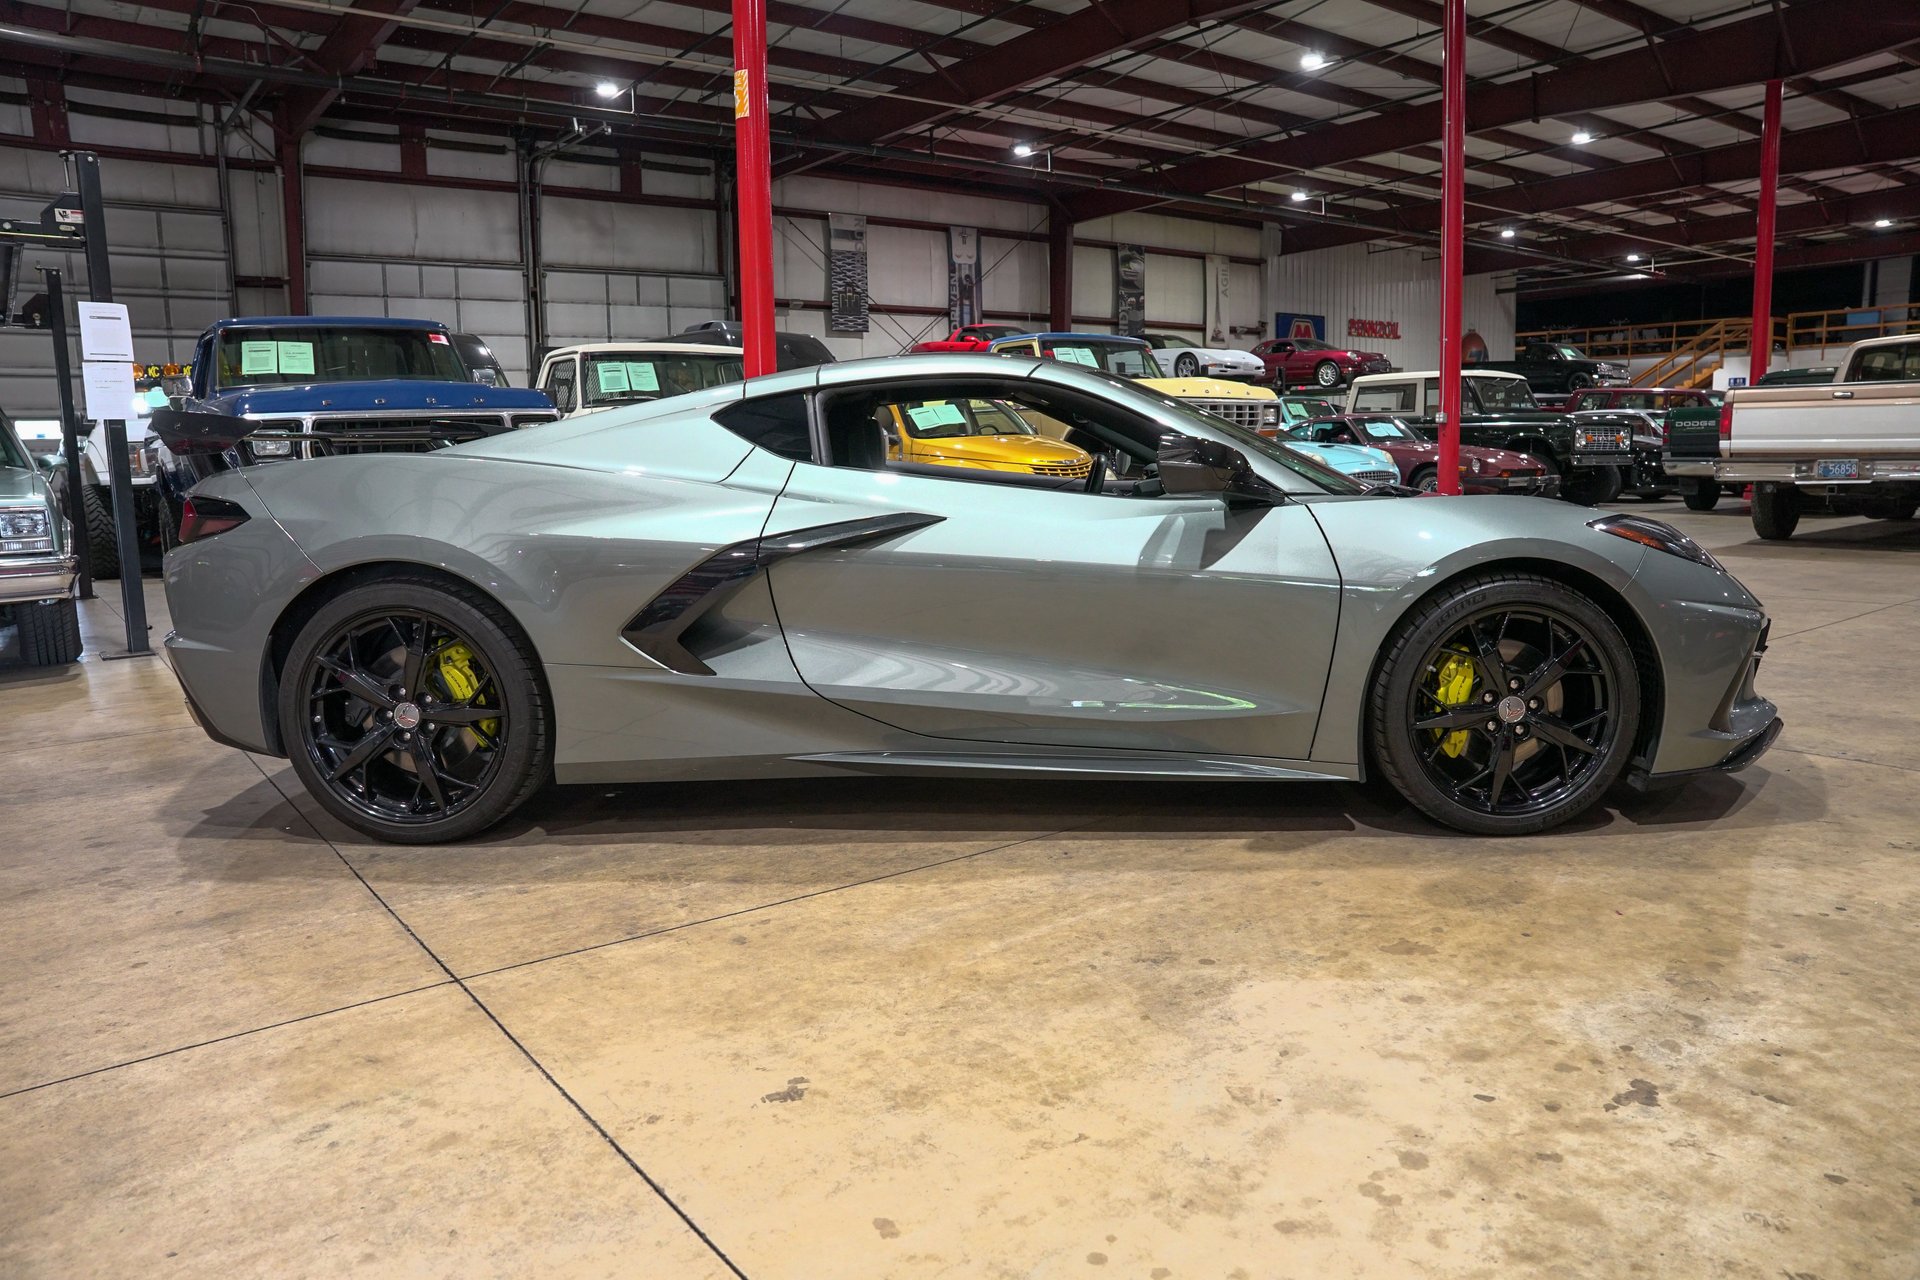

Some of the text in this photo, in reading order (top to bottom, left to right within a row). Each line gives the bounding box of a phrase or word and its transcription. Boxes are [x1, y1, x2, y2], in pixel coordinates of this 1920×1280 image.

[950, 272, 959, 332] DRIVEN
[1347, 318, 1401, 339] PENNZOIL
[147, 365, 160, 379] KC
[1828, 463, 1857, 475] 56858
